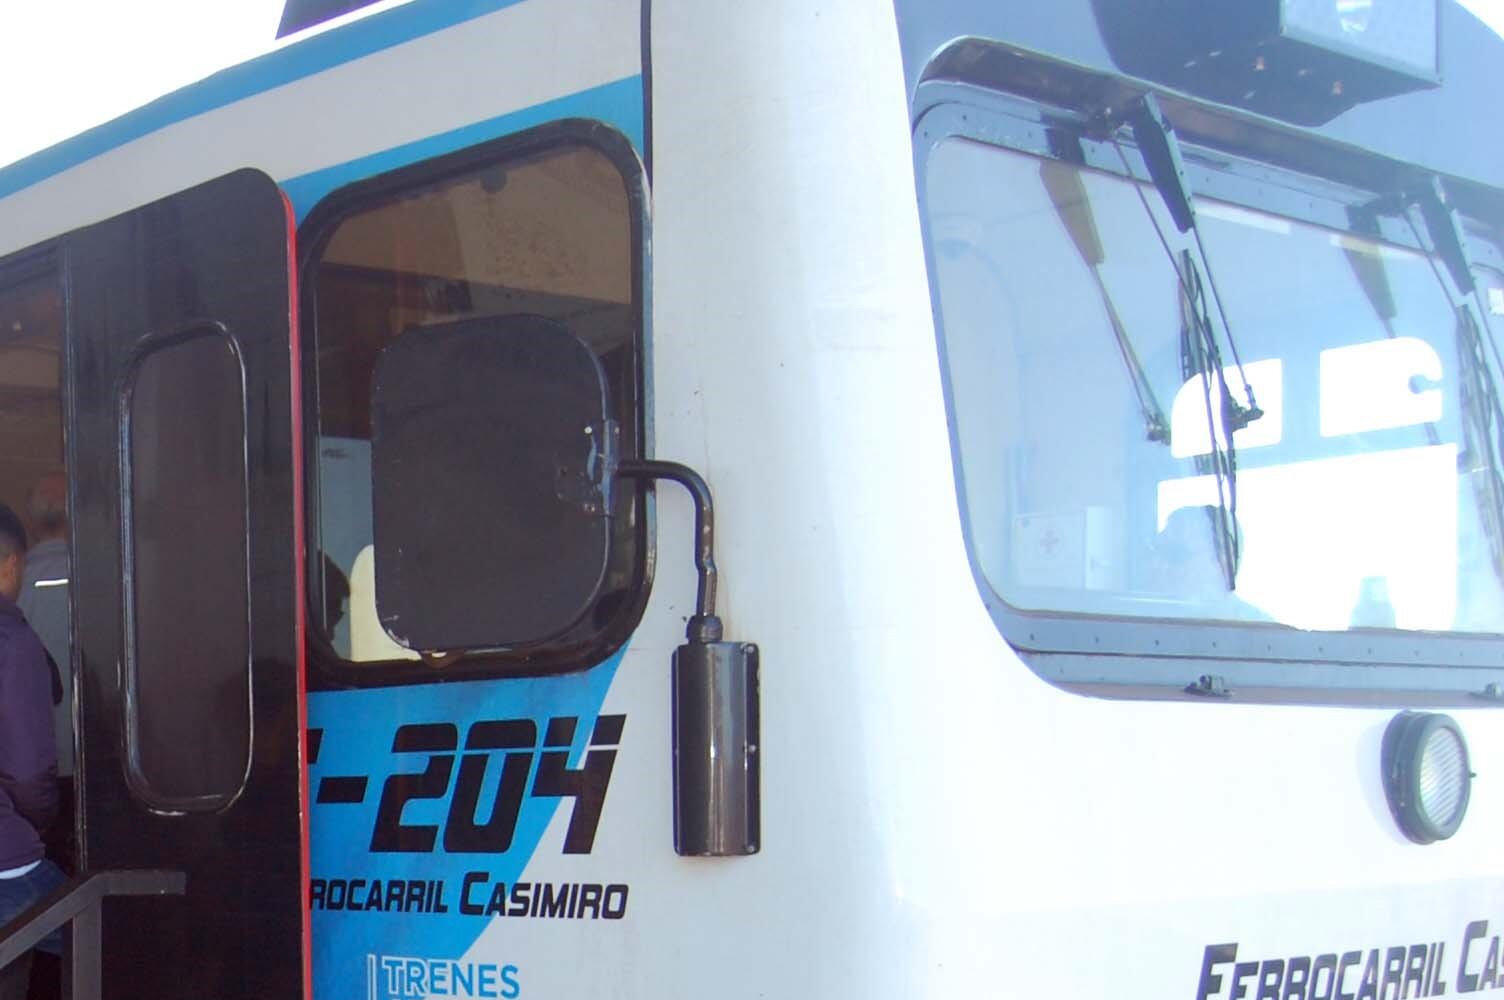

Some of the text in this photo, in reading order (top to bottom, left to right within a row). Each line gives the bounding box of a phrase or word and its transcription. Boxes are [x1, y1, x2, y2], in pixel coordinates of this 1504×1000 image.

[307, 714, 626, 854] -204
[459, 872, 628, 919] CASIMIRO
[382, 957, 521, 999] TRENES
[1456, 920, 1504, 993] CA
